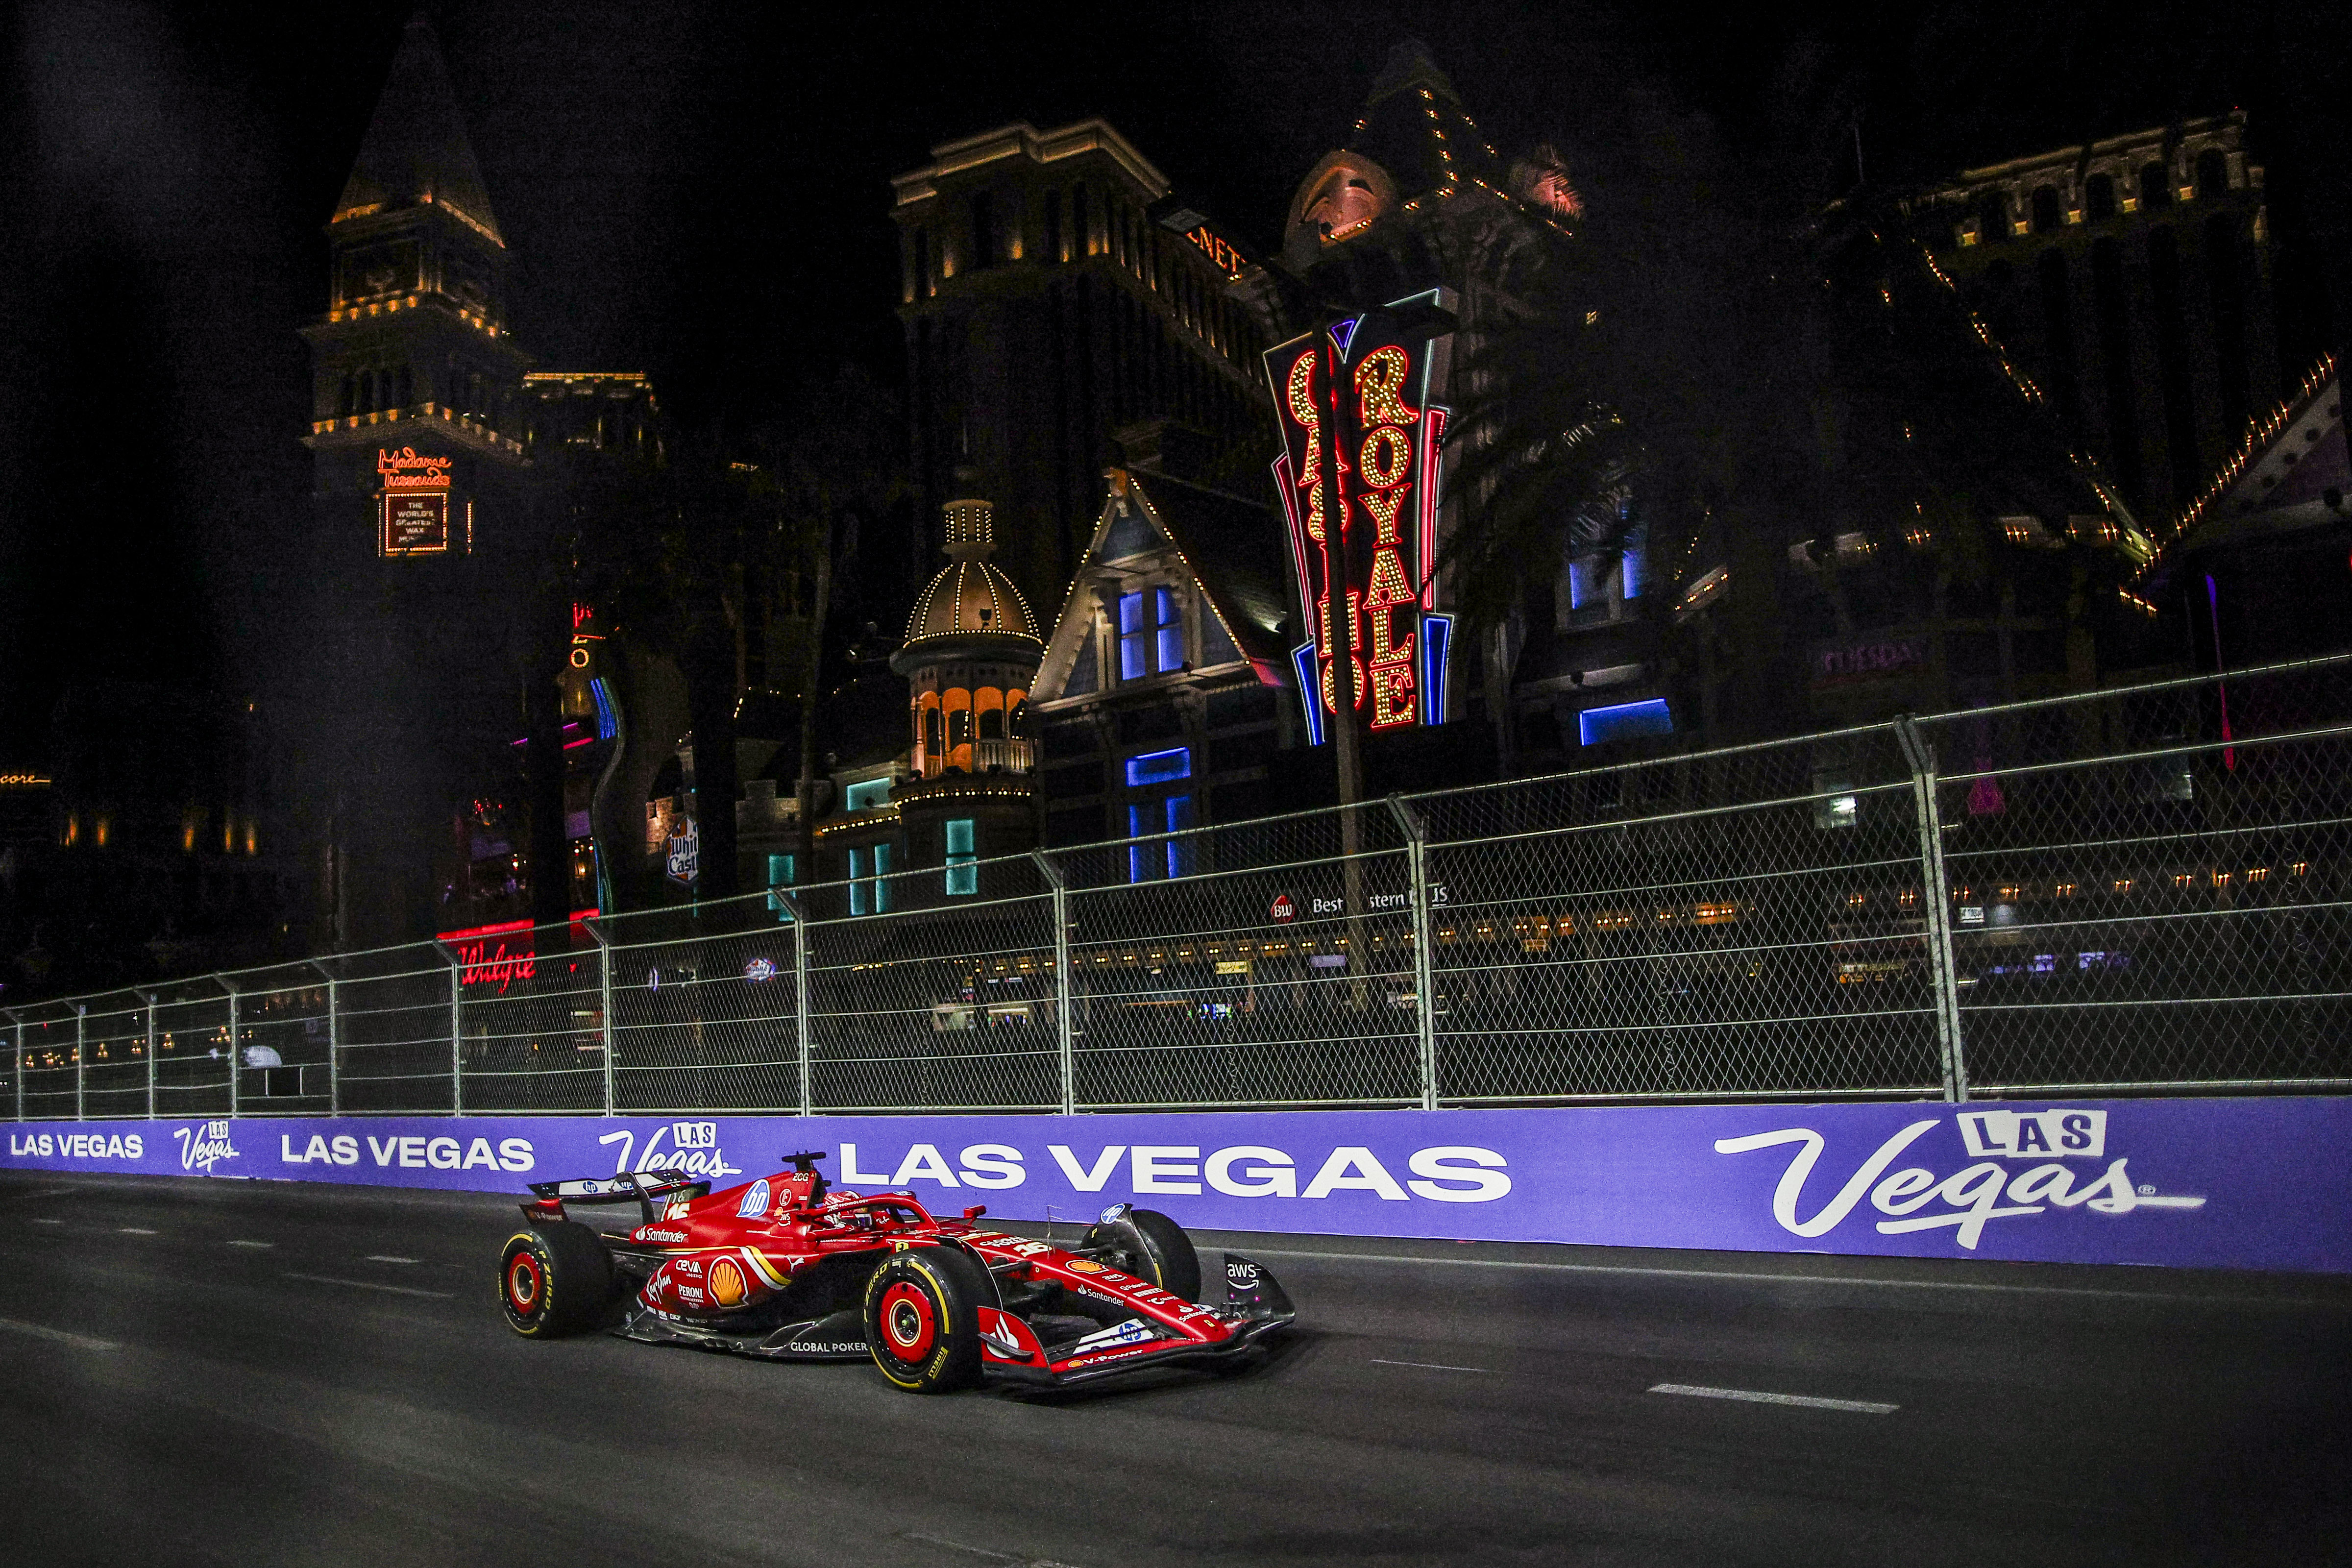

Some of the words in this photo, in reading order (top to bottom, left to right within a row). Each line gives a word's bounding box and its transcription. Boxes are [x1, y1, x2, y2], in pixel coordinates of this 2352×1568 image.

[378, 446, 452, 468] Madame
[377, 466, 451, 488] Tussauds
[1354, 345, 1420, 728] ROYALE
[1313, 897, 1344, 913] Best
[211, 1123, 226, 1136] LAS
[678, 1126, 711, 1145] LAS
[1971, 1113, 2093, 1152] LAS
[11, 1134, 53, 1156] LAS
[57, 1134, 143, 1158] VEGAS
[173, 1124, 240, 1172] Vegas
[282, 1134, 359, 1165] LAS
[367, 1136, 535, 1172] VEGAS
[839, 1143, 1027, 1189] LAS
[1047, 1145, 1512, 1203] VEGAS
[585, 1181, 597, 1193] hp
[1714, 1119, 2206, 1250] Vegas
[741, 1180, 768, 1217] hp
[838, 1199, 868, 1208] TECHNOLOGY
[1102, 1203, 1125, 1224] hp
[646, 1227, 689, 1243] Santander
[1013, 1242, 1053, 1257] 16
[1227, 1263, 1256, 1278] aws
[543, 1262, 553, 1310] ZERO
[678, 1284, 704, 1299] PERONI
[1087, 1288, 1125, 1307] Santander
[790, 1342, 830, 1352] GLOBAL
[833, 1342, 868, 1351] POKER
[1083, 1348, 1143, 1364] V-Power
